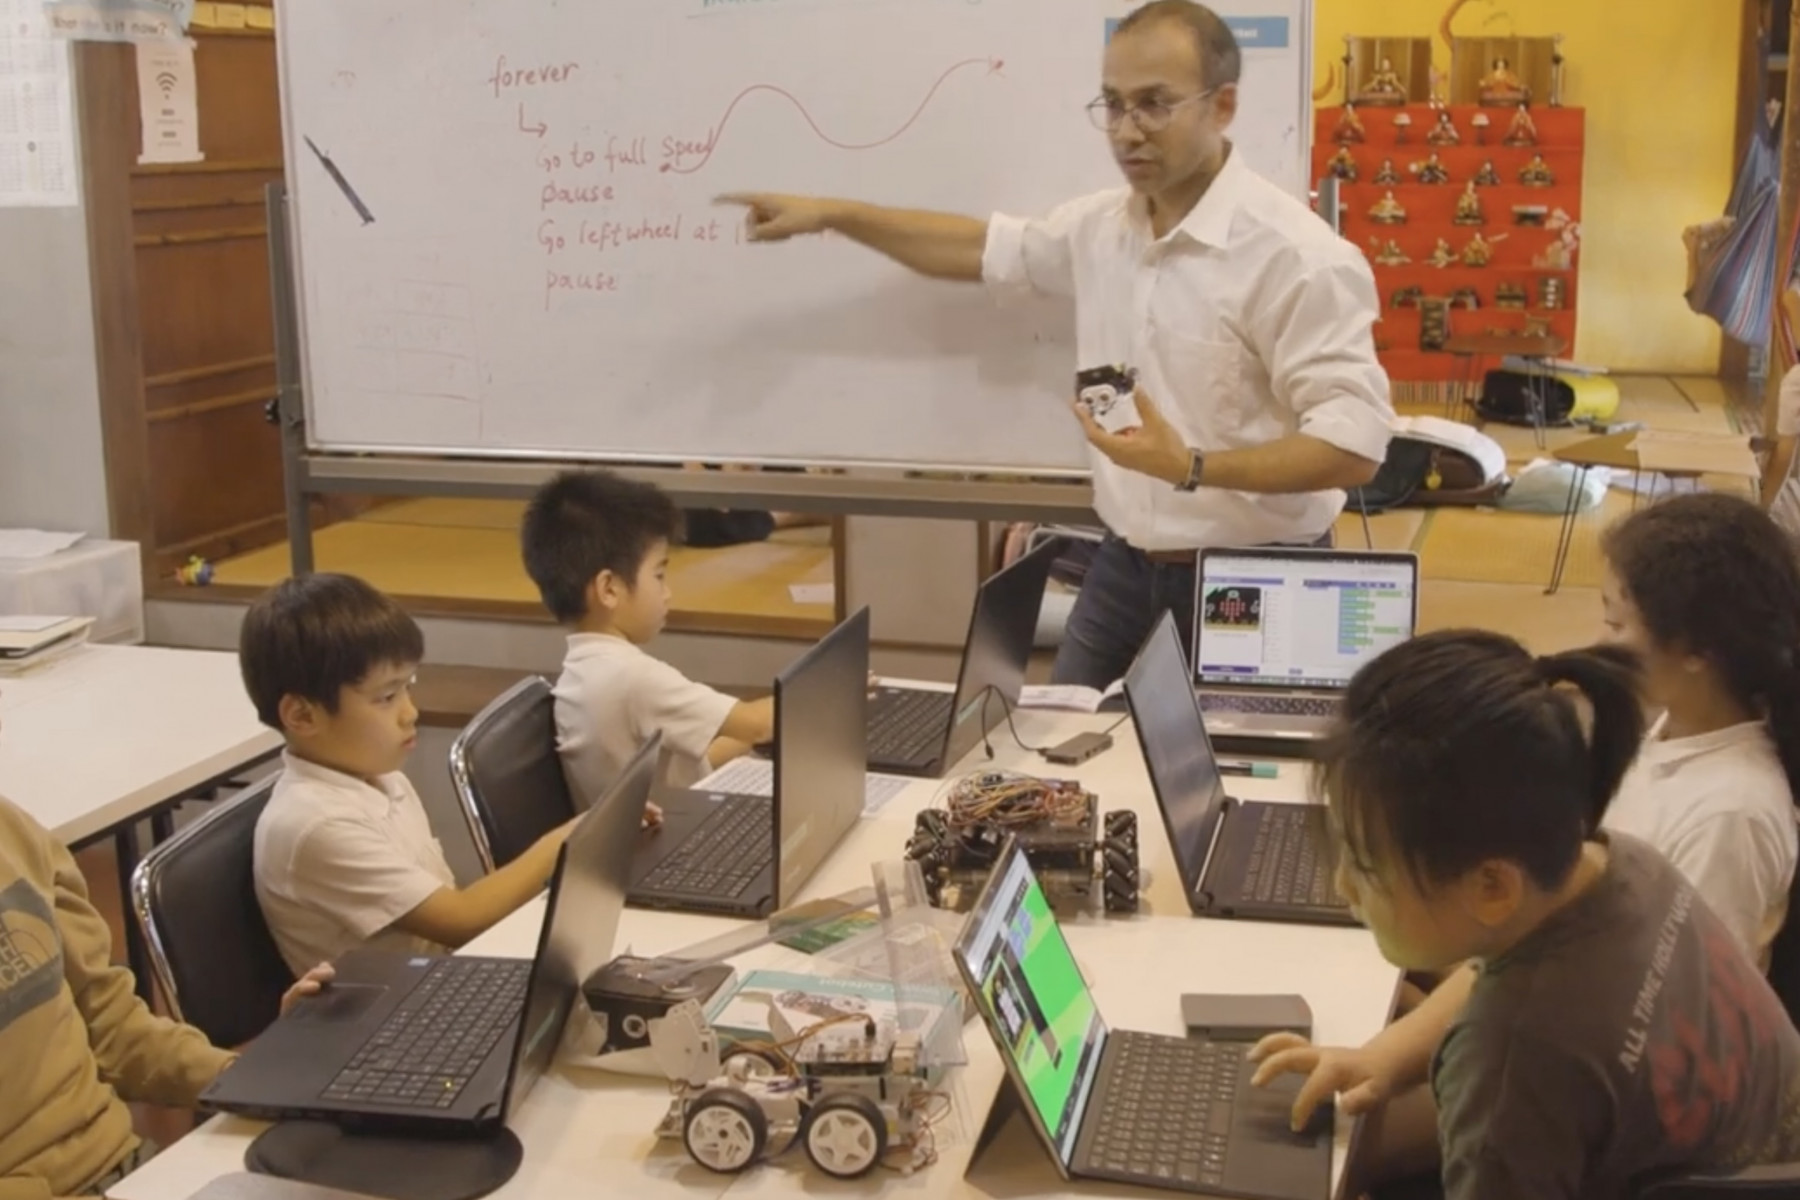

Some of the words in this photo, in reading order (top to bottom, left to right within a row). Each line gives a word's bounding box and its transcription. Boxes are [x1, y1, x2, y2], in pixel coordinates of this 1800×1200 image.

[489, 54, 579, 98] forever
[570, 142, 596, 168] to
[605, 136, 647, 173] full
[541, 181, 615, 212] pause
[537, 219, 565, 255] Go
[693, 219, 721, 242] at
[545, 269, 618, 312] pause
[1632, 967, 1664, 1024] TIME
[1618, 1026, 1648, 1074] ALL
